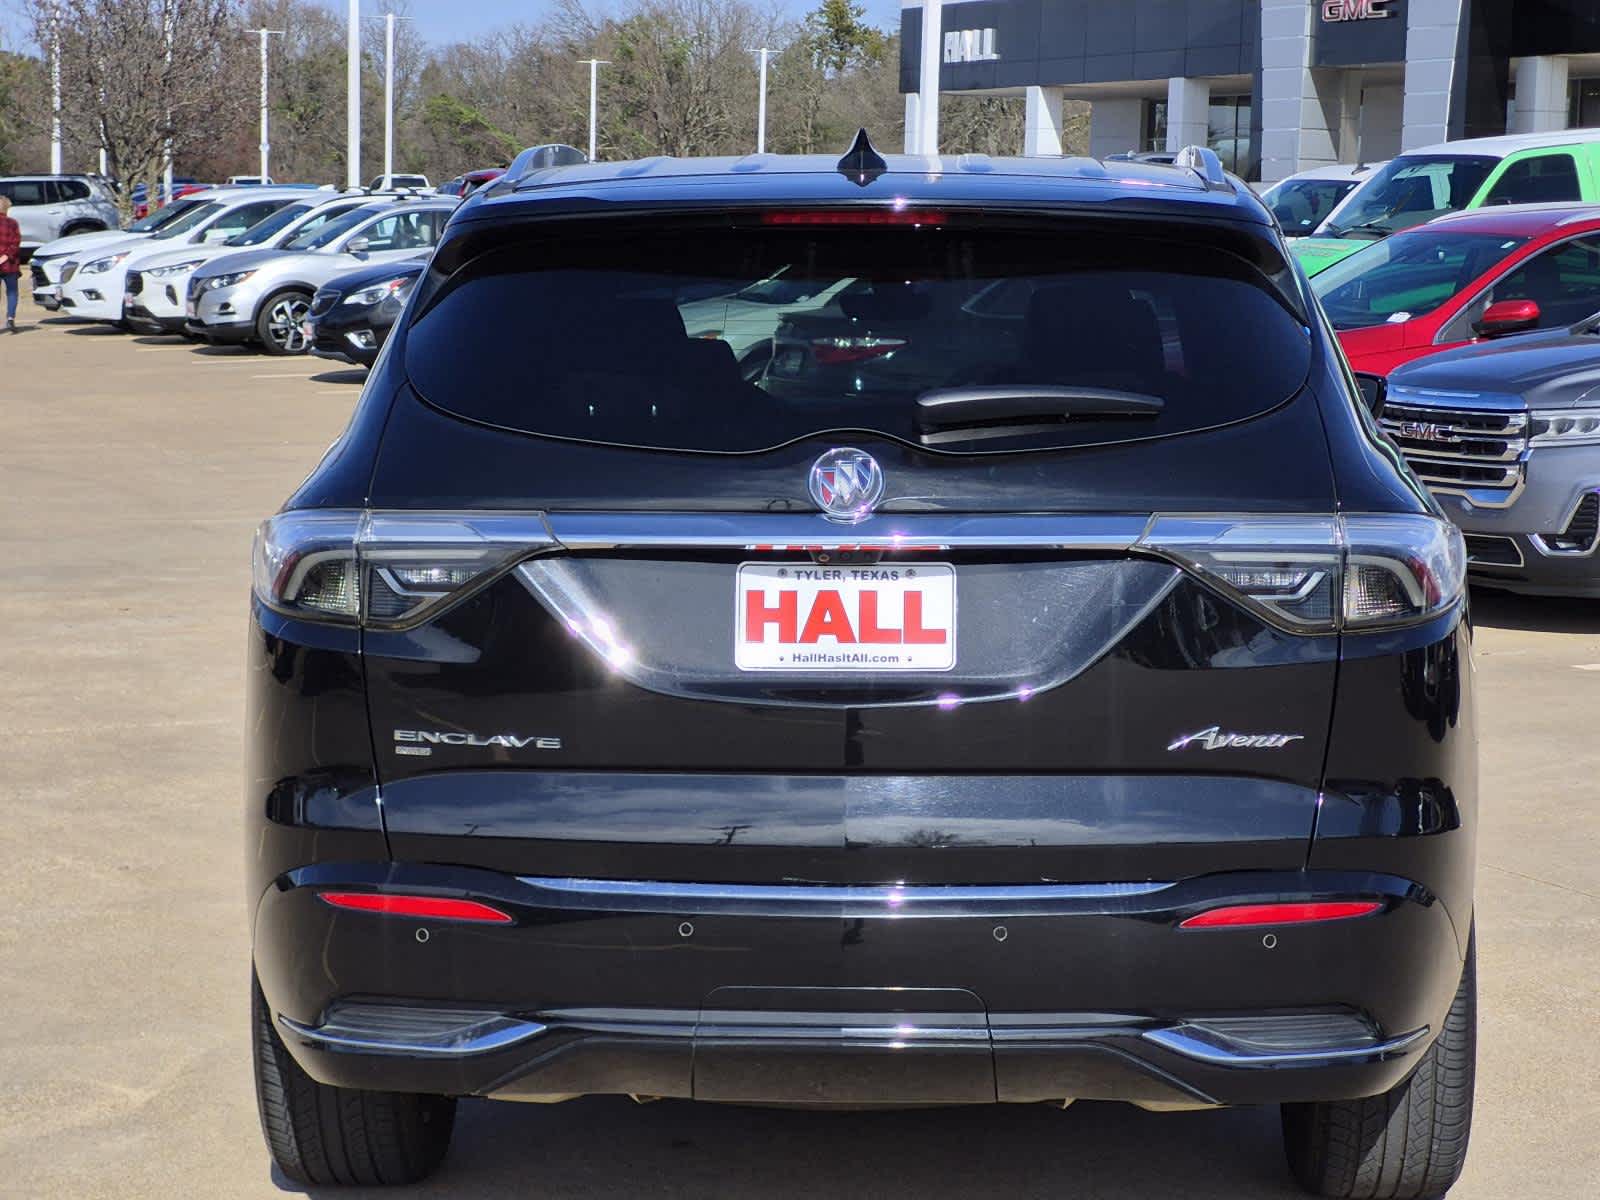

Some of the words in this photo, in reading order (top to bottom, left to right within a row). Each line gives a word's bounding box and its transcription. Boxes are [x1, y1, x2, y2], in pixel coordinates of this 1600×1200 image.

[1322, 0, 1389, 21] GMC
[943, 28, 1000, 63] HALL
[1400, 422, 1453, 442] GMC
[795, 569, 846, 582] TYLER,
[851, 570, 899, 580] TEXAS
[746, 590, 947, 643] HALL
[792, 653, 899, 663] HallHasItAll.com
[393, 729, 561, 748] ENCLAVE
[1167, 726, 1304, 750] Avenir
